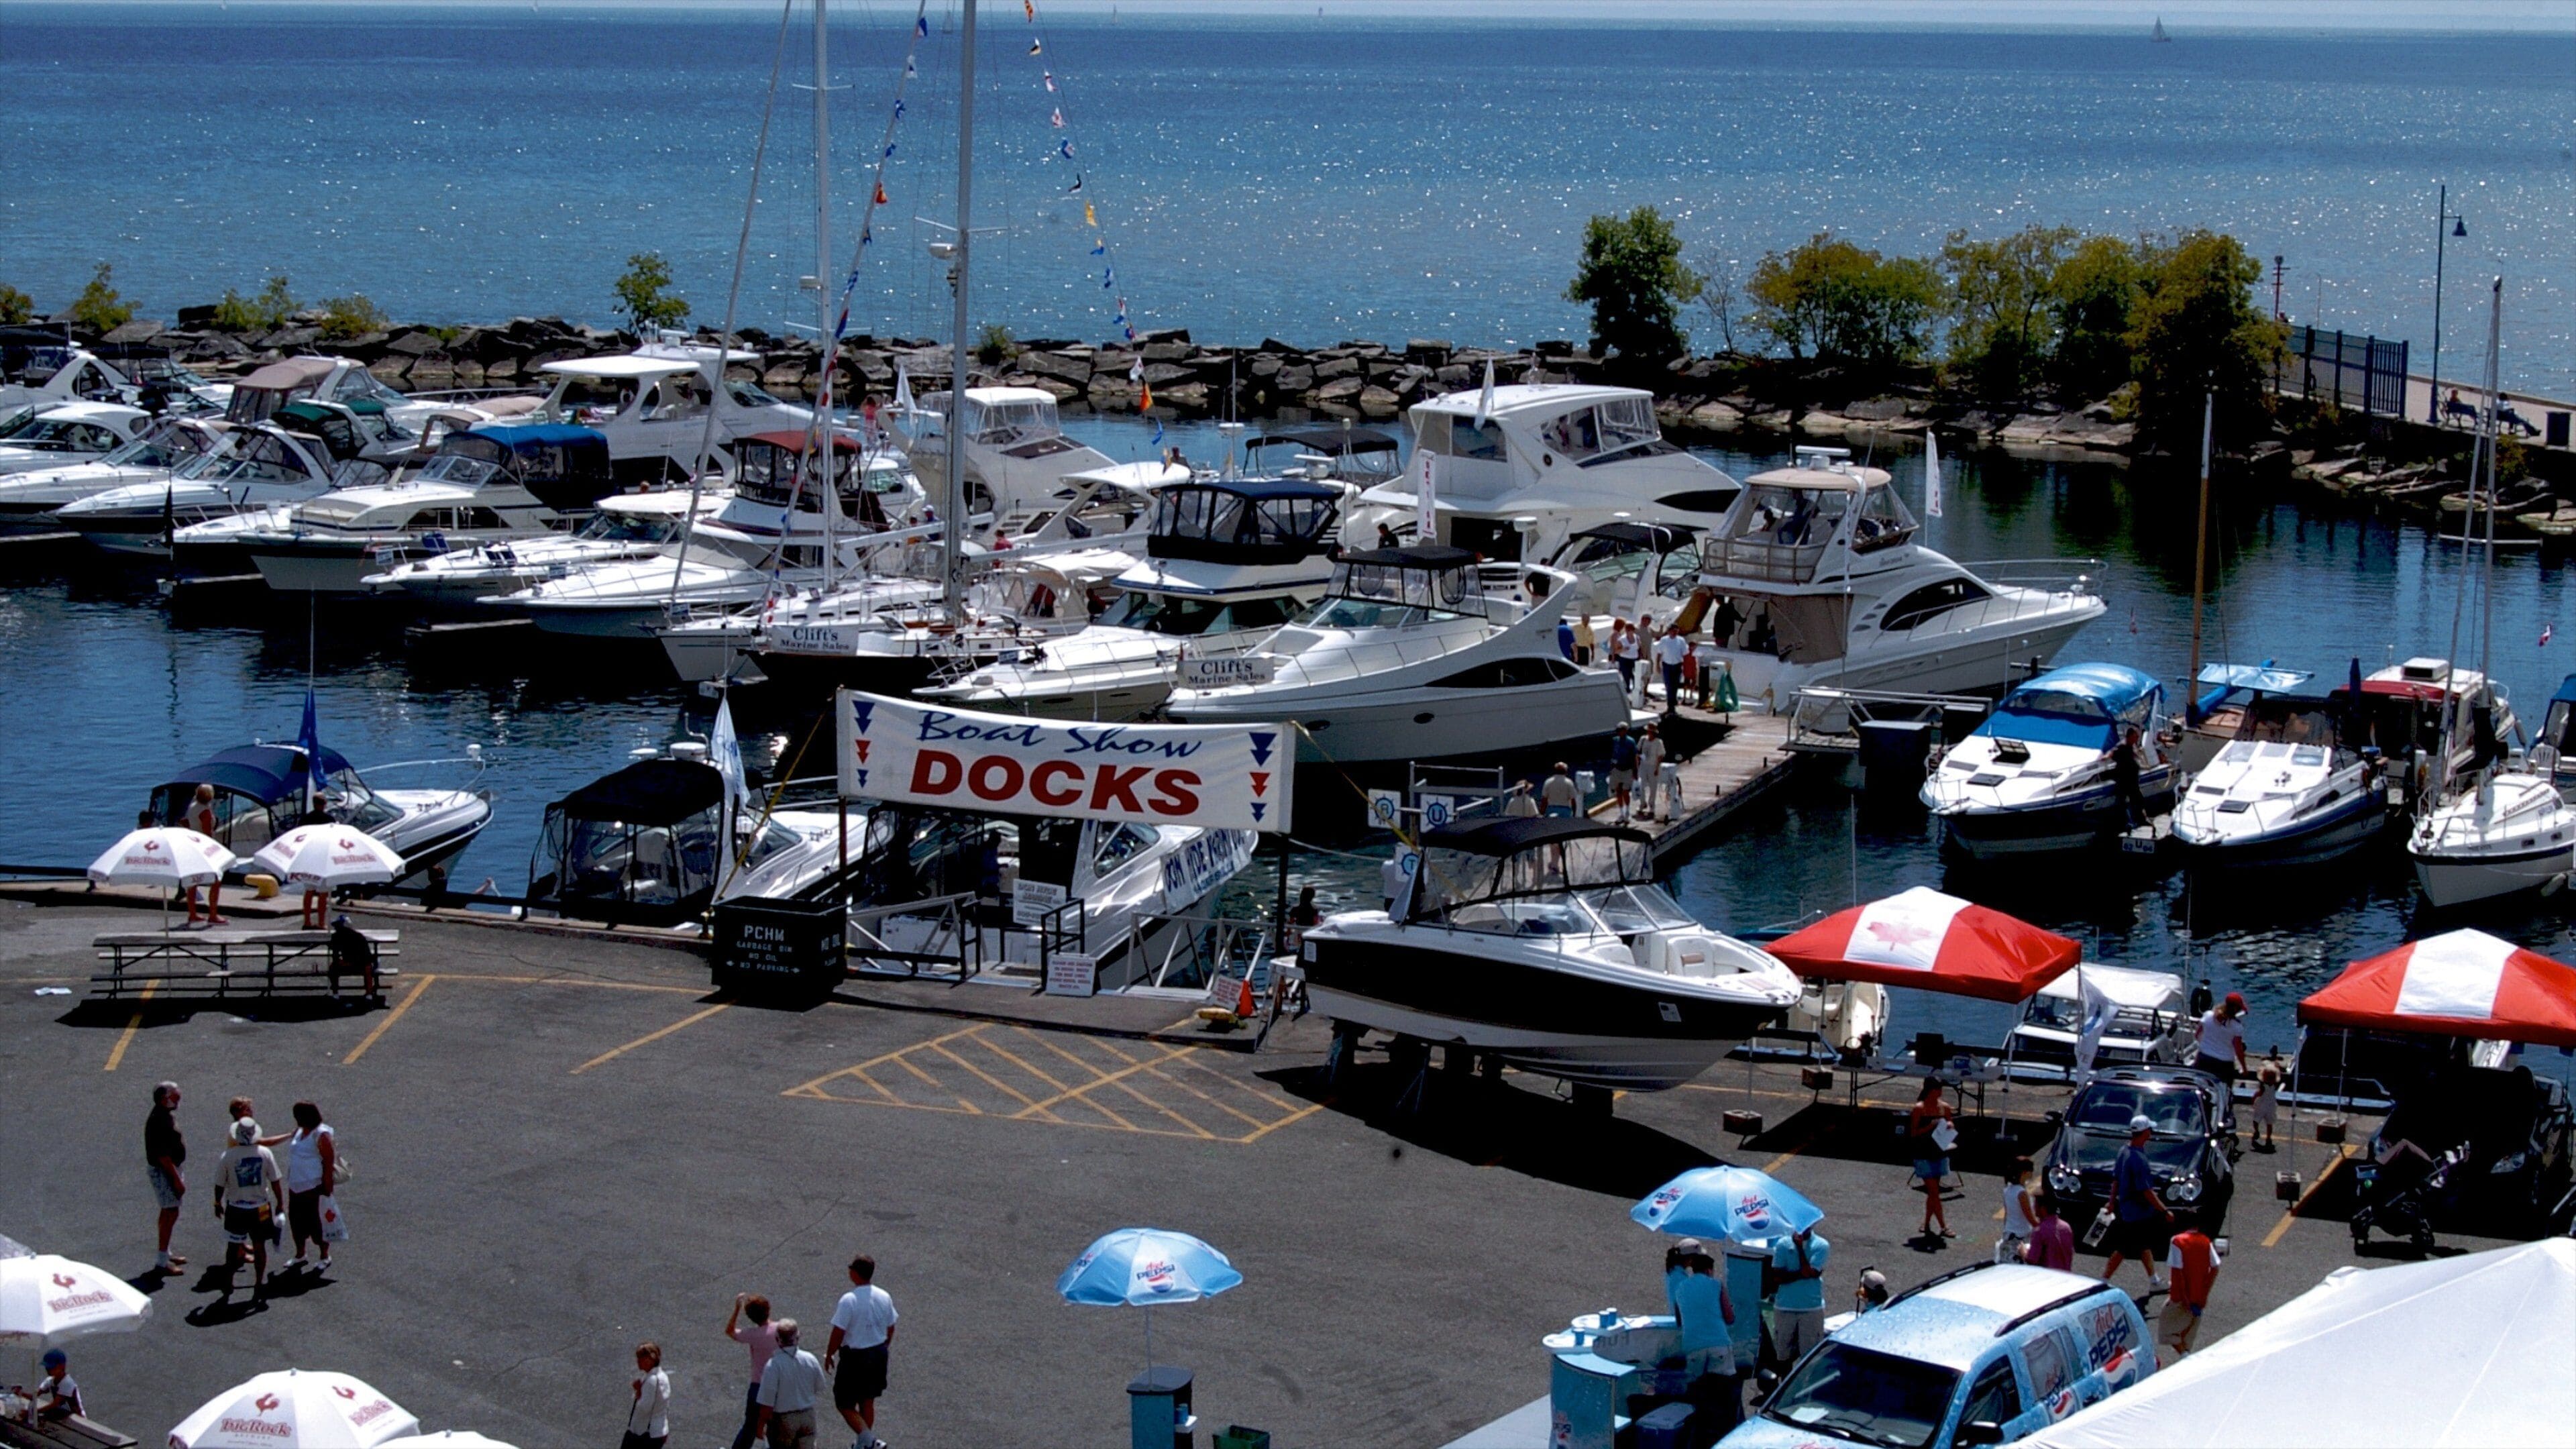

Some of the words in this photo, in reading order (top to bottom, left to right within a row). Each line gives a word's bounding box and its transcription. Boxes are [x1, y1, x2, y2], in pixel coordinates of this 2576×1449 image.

[793, 628, 838, 640] Clift's
[780, 639, 818, 649] Marine
[822, 641, 849, 650] Sales
[1201, 659, 1252, 674] Clift's
[1188, 674, 1232, 684] Marine
[1236, 672, 1265, 682] Sales
[916, 709, 1047, 747] Boat
[1063, 727, 1202, 758] Show
[910, 749, 1202, 816] DOCKS
[1432, 808, 1442, 821] U
[1409, 859, 1415, 870] T
[744, 924, 784, 941] PCHM
[736, 941, 772, 951] GARBAGE
[757, 963, 789, 973] PARKING
[1734, 1199, 1770, 1216] PEPSI
[1136, 1264, 1175, 1280] PEPSI
[2095, 1303, 2115, 1337] diet
[2088, 1312, 2131, 1373] PEPSI
